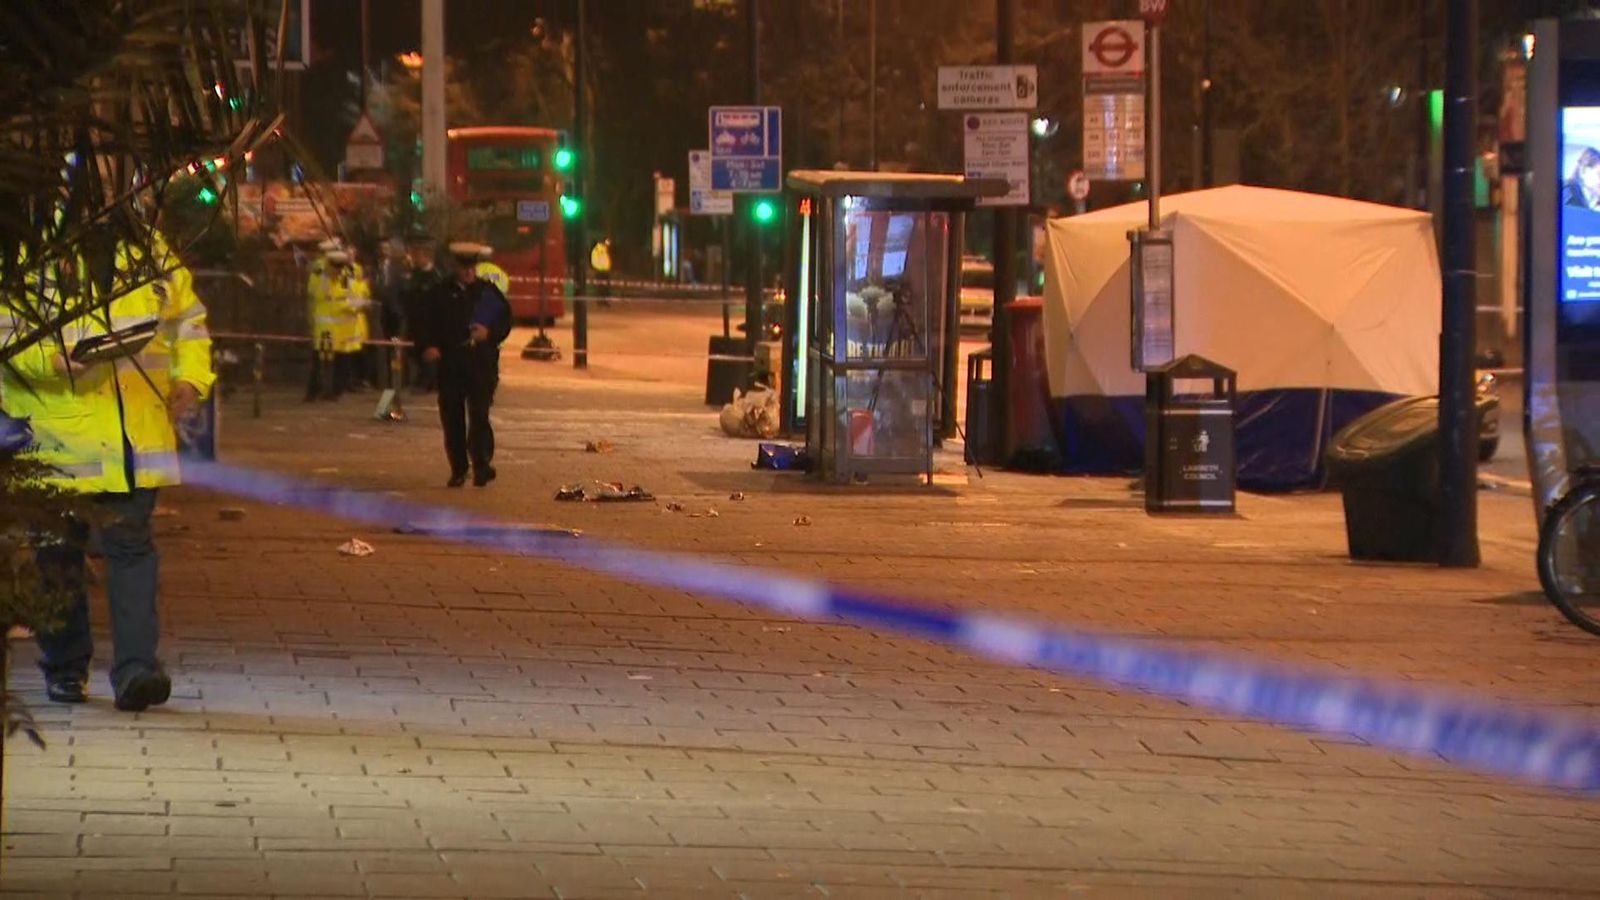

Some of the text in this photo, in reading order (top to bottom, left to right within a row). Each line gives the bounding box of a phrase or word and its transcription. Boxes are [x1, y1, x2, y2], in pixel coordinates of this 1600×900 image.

[959, 70, 994, 80] Traffic
[941, 82, 1012, 92] enforcement
[953, 96, 1000, 105] cameras
